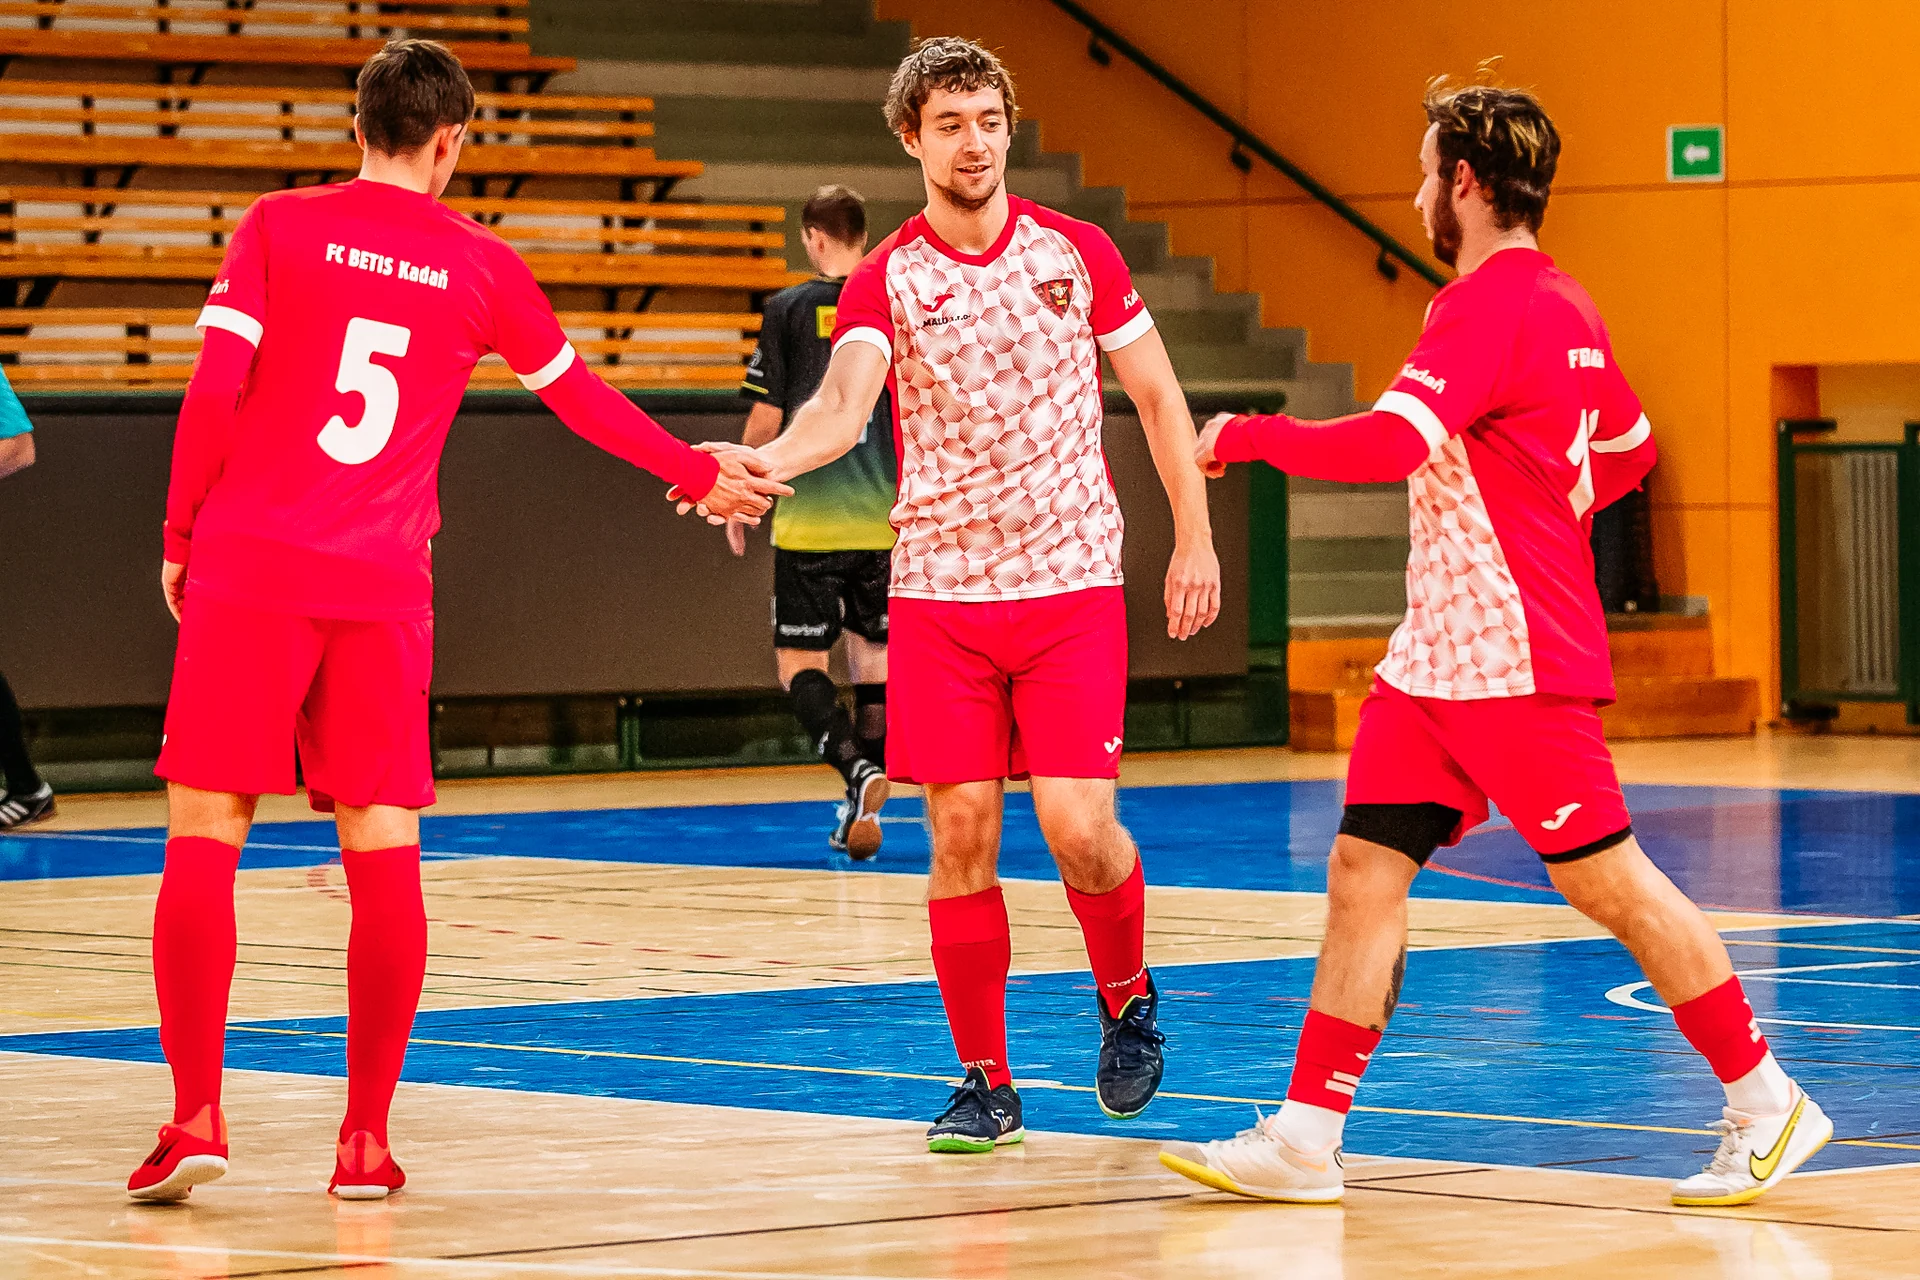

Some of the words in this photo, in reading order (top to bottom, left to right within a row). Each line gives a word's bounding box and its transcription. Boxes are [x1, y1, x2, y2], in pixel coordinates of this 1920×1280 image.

[325, 243, 345, 265] FC
[348, 247, 394, 276] BETIS
[397, 260, 449, 290] Kadaň
[316, 316, 412, 465] 5
